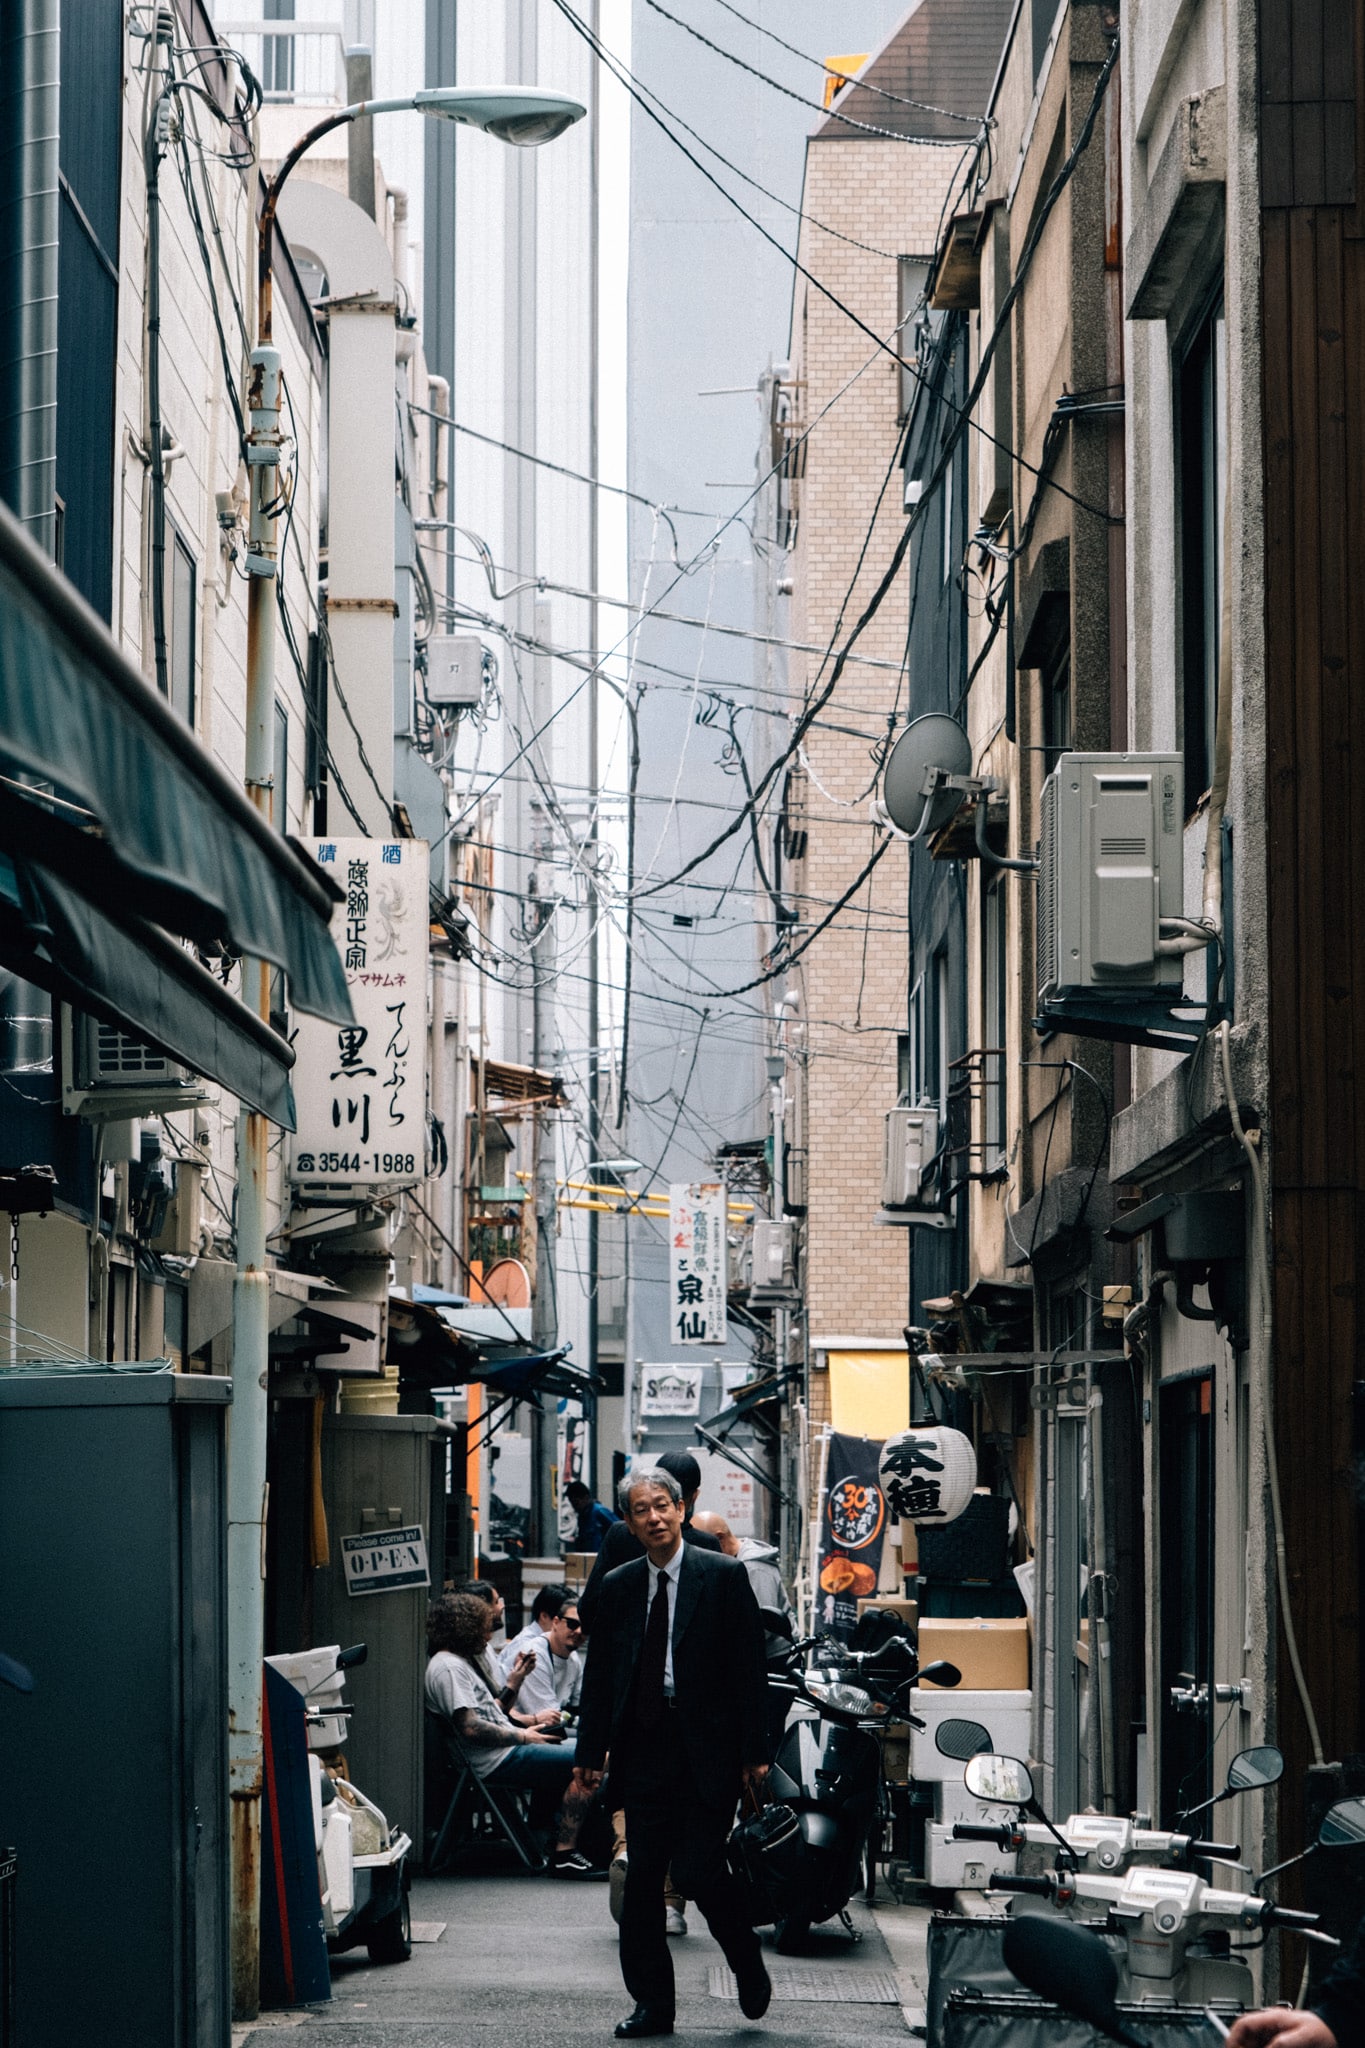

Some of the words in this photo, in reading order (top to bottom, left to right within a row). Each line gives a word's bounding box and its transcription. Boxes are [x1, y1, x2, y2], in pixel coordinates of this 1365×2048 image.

[329, 1025, 377, 1144] 黒川
[383, 1001, 410, 1127] てんぷら
[319, 1152, 415, 1173] 3544-1988
[347, 1538, 378, 1549] Please
[380, 1534, 404, 1545] come
